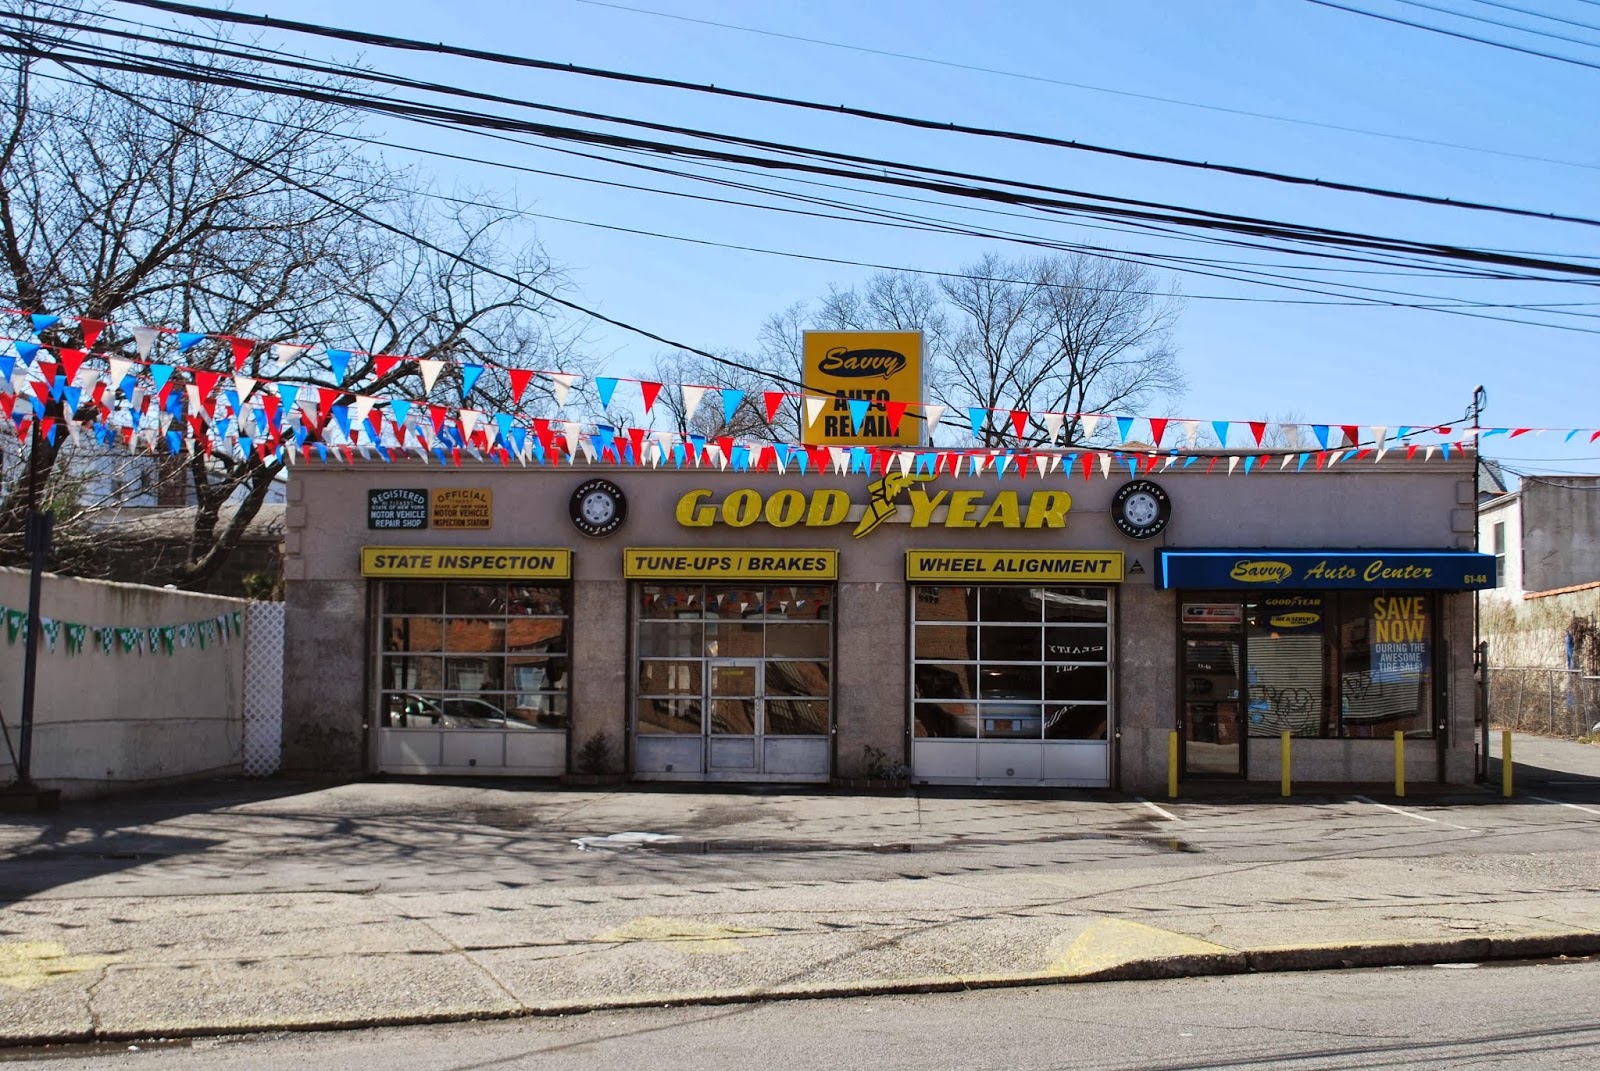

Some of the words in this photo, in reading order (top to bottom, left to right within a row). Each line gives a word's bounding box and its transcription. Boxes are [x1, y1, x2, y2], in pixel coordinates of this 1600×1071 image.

[821, 347, 906, 379] Savvy
[371, 490, 425, 505] REGISTERED
[438, 490, 486, 503] OFFICIAL
[371, 511, 395, 519] MOTOR
[396, 511, 426, 519] VEHICLE
[434, 509, 458, 517] MOTOR
[459, 509, 489, 517] VEHICLE
[375, 519, 401, 527] REPAIR
[403, 519, 422, 527] SHOP
[433, 519, 465, 527] INSPECTION
[467, 519, 489, 527] STATION
[374, 555, 433, 568] STATE
[437, 555, 556, 570] INSPECTION
[635, 556, 732, 570] TUNE-UPS
[747, 557, 827, 571] BRAKES
[919, 558, 987, 572] WHEEL
[992, 558, 1112, 574] ALIGNMENT
[1232, 560, 1292, 583] Savvy
[1303, 560, 1355, 580] Auto
[1363, 559, 1433, 582] Center
[1464, 574, 1488, 584] 61-44
[1374, 596, 1425, 620] SAVE
[1375, 620, 1425, 643] NOW
[1375, 643, 1408, 653] DURING
[1410, 642, 1426, 653] THE
[1380, 652, 1421, 662] AWESOME
[1379, 662, 1398, 672] TIRE
[1400, 662, 1423, 672] SALE!
